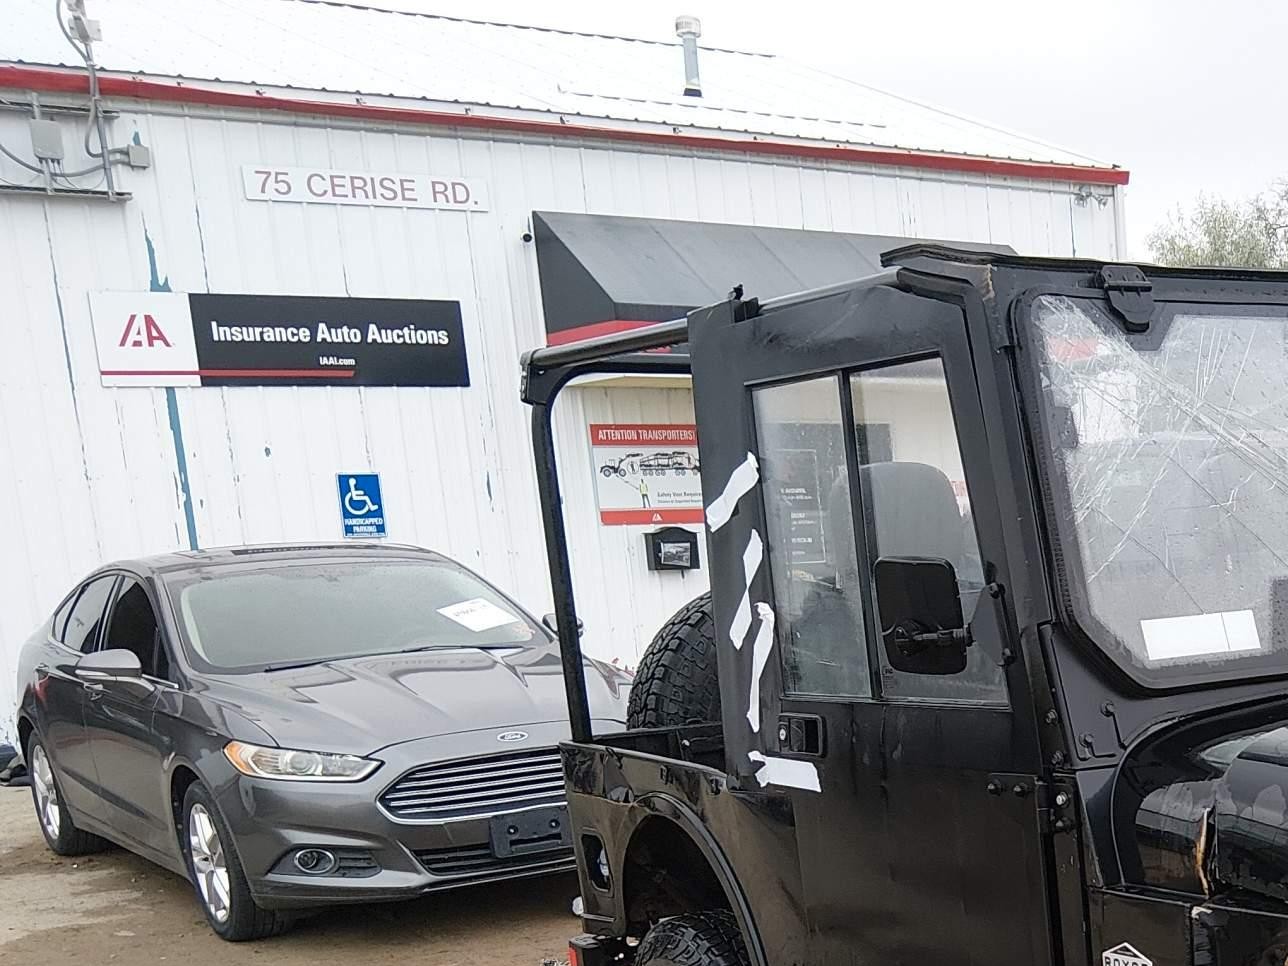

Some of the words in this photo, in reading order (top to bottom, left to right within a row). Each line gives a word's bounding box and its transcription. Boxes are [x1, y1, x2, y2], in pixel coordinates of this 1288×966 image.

[254, 170, 292, 195] 75
[306, 173, 418, 202] CERISE
[431, 180, 479, 205] RD.
[210, 321, 311, 343] Insurance
[316, 322, 362, 344] Auto
[367, 323, 450, 345] Auctions
[598, 429, 637, 441] ATTENTION
